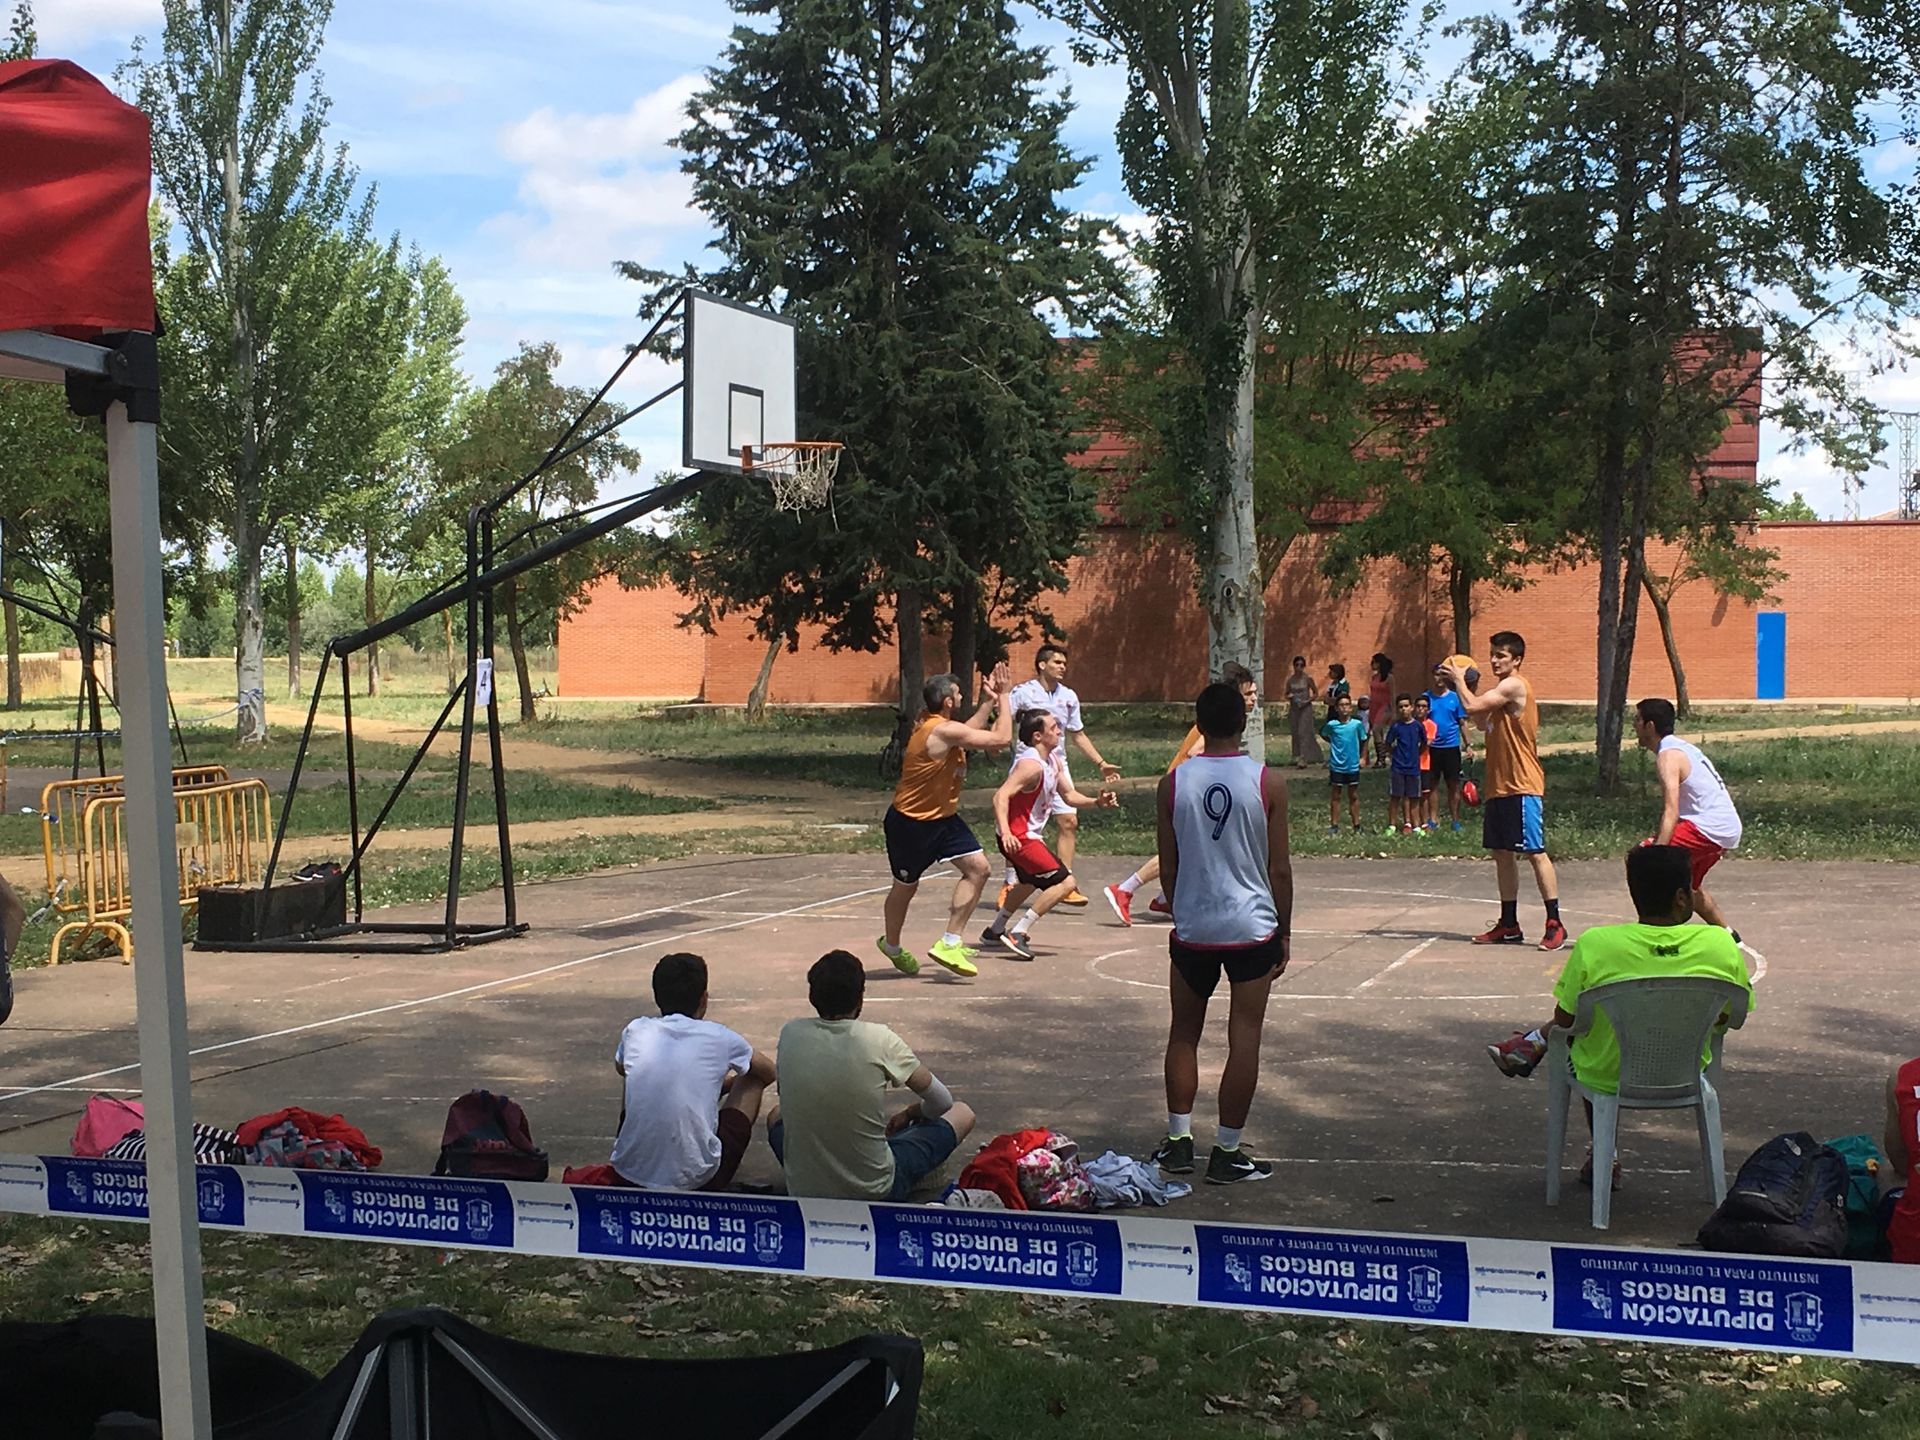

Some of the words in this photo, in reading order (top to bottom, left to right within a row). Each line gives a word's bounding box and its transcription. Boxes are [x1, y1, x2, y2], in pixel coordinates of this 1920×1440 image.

[1203, 783, 1232, 840] 9
[92, 1172, 147, 1188] URGOS
[93, 1190, 148, 1208] TACIÓN
[352, 1191, 425, 1210] BURGOS
[434, 1197, 459, 1212] DE
[353, 1208, 458, 1231] DIPUTACIÓN
[630, 1211, 709, 1231] BURGOS
[718, 1217, 746, 1233] DE
[631, 1229, 746, 1253] DIPUTACIÓN
[931, 1232, 1018, 1252] BURGOS
[1028, 1239, 1057, 1255] DE
[1222, 1235, 1274, 1246] JUVENTUD
[1286, 1239, 1333, 1251] DEPORTE
[1336, 1242, 1348, 1252] EL
[1351, 1244, 1379, 1254] PARA
[1382, 1245, 1438, 1258] INSTITUTO
[932, 1252, 1057, 1276] DIPUTACIÓN
[1260, 1255, 1354, 1277] BURGOS
[1366, 1262, 1397, 1280] DE
[1580, 1258, 1638, 1271] JUVENTUD
[1651, 1263, 1703, 1276] DEPORTE
[1707, 1266, 1719, 1277] EL
[1724, 1268, 1754, 1279] PARA
[1758, 1270, 1819, 1284] INSTITUTO
[1261, 1276, 1397, 1303] DIPUTACIÓN
[1621, 1280, 1726, 1304] BURGOS
[1739, 1289, 1774, 1308] DE
[1622, 1302, 1774, 1331] DIPUTACIÓN
